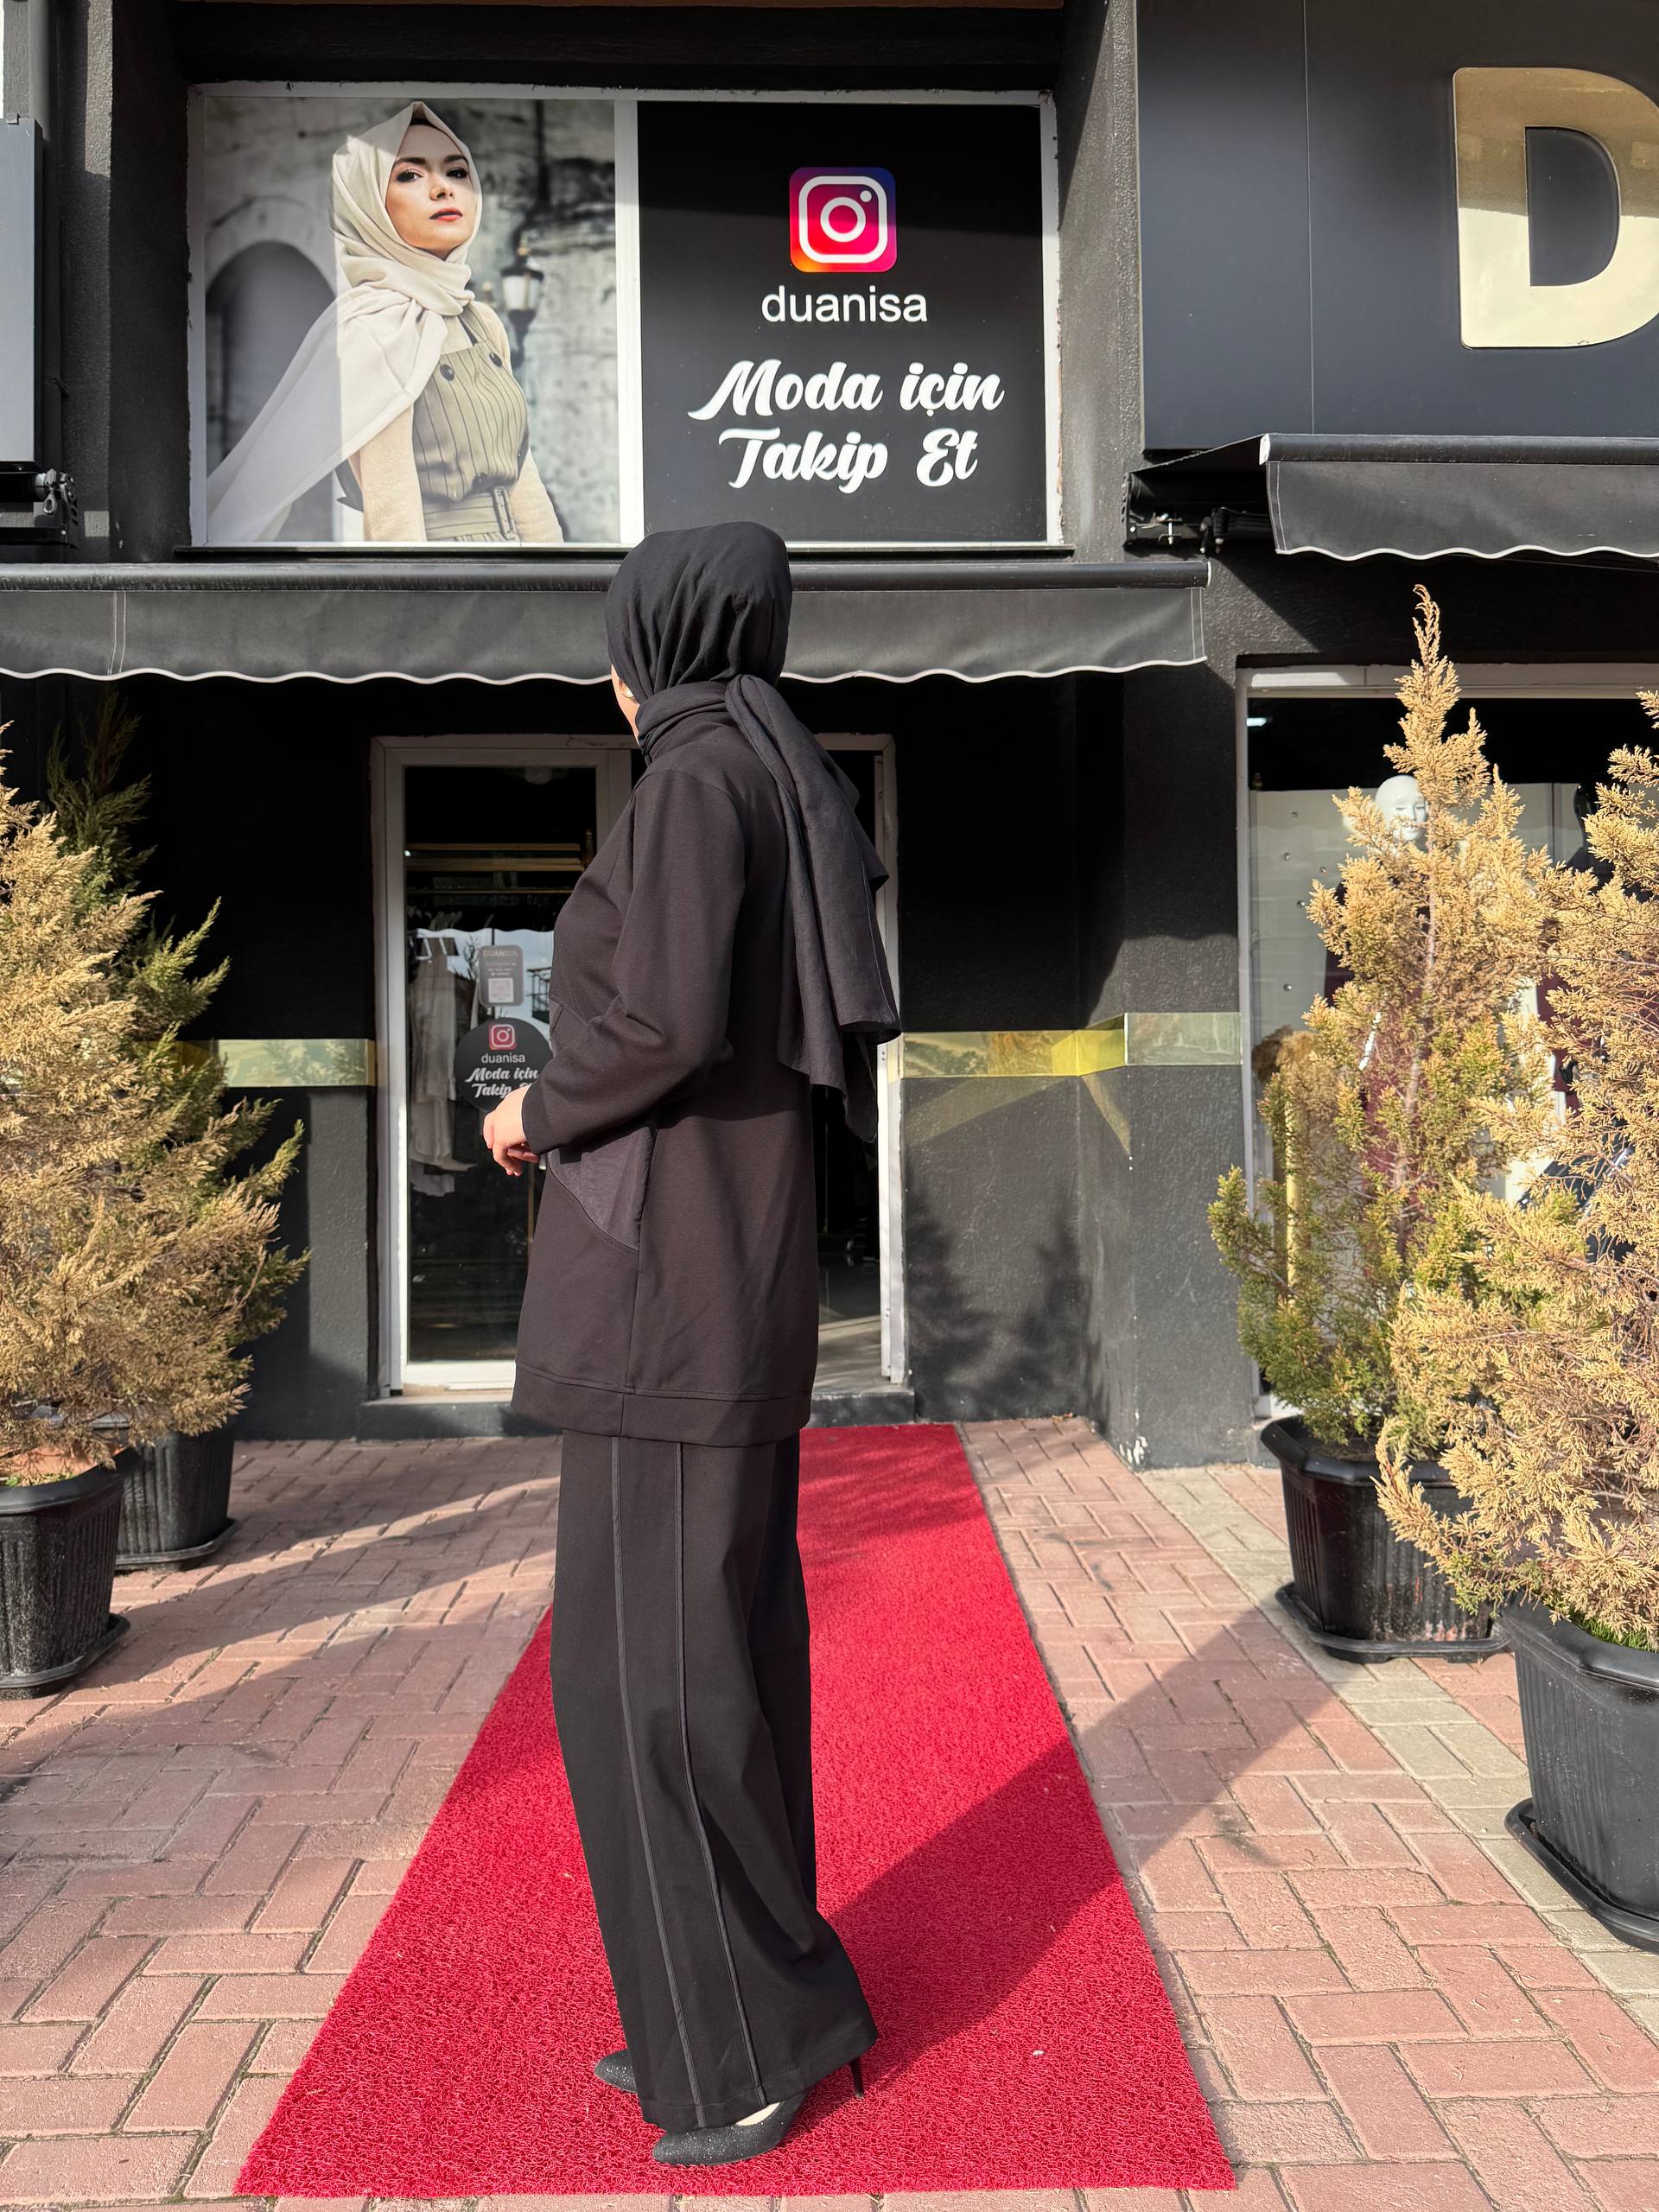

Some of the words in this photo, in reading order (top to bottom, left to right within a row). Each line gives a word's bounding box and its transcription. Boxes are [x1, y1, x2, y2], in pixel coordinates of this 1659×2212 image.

[761, 285, 928, 323] duanisa
[687, 359, 883, 421] Moda
[899, 362, 1005, 417] için
[718, 427, 889, 494] Takip
[916, 428, 979, 488] Et
[481, 1052, 526, 1064] duanisa
[464, 1067, 511, 1083] Moda
[513, 1067, 539, 1080] için
[471, 1083, 512, 1098] Takip
